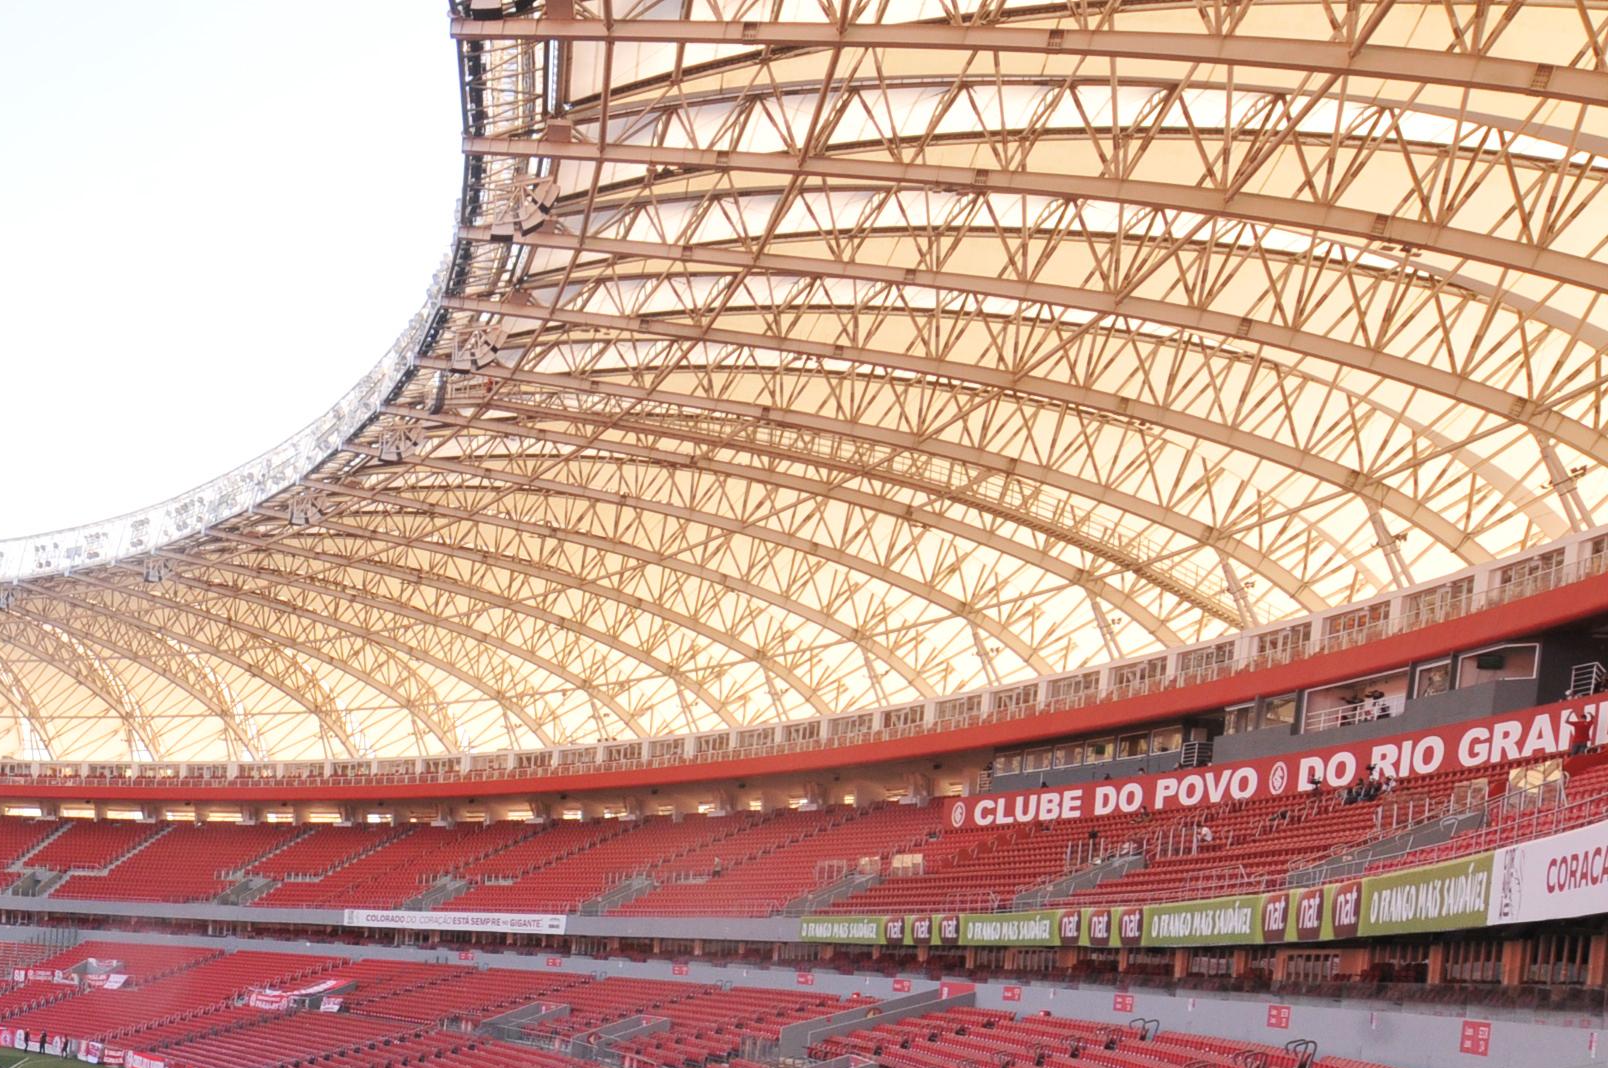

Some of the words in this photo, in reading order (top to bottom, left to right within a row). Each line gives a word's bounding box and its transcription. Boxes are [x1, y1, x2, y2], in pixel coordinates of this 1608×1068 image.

[974, 789, 1083, 826] CLUBE
[1094, 783, 1143, 816] DO
[1155, 767, 1258, 809] POVO
[1297, 751, 1356, 792] DO
[1371, 735, 1445, 782] RIO
[1459, 701, 1608, 767] GRAN
[1335, 885, 1358, 927] nat
[1370, 892, 1378, 924] O
[1379, 885, 1416, 924] FRANGO
[1442, 862, 1487, 917] SAUDÁVEL
[366, 914, 406, 924] COLORADO
[471, 917, 501, 927] SEMPRE
[1151, 915, 1158, 938] O
[1159, 912, 1191, 938] FRANGO
[1214, 900, 1252, 936] SAUDÁVEL
[1265, 898, 1286, 932] nat
[1299, 891, 1320, 929] nat
[801, 924, 807, 936] O
[808, 922, 831, 938] FRANGO
[850, 919, 877, 938] SAUDÁVEL
[887, 919, 902, 939] nat
[914, 919, 929, 939] nat
[942, 917, 957, 939] nat
[967, 923, 973, 939] O
[974, 921, 1000, 940] FRANGO
[1020, 915, 1050, 940] SAUDÁVEL
[1061, 910, 1078, 938] nat
[1091, 911, 1109, 938] nat
[1122, 911, 1140, 938] nat
